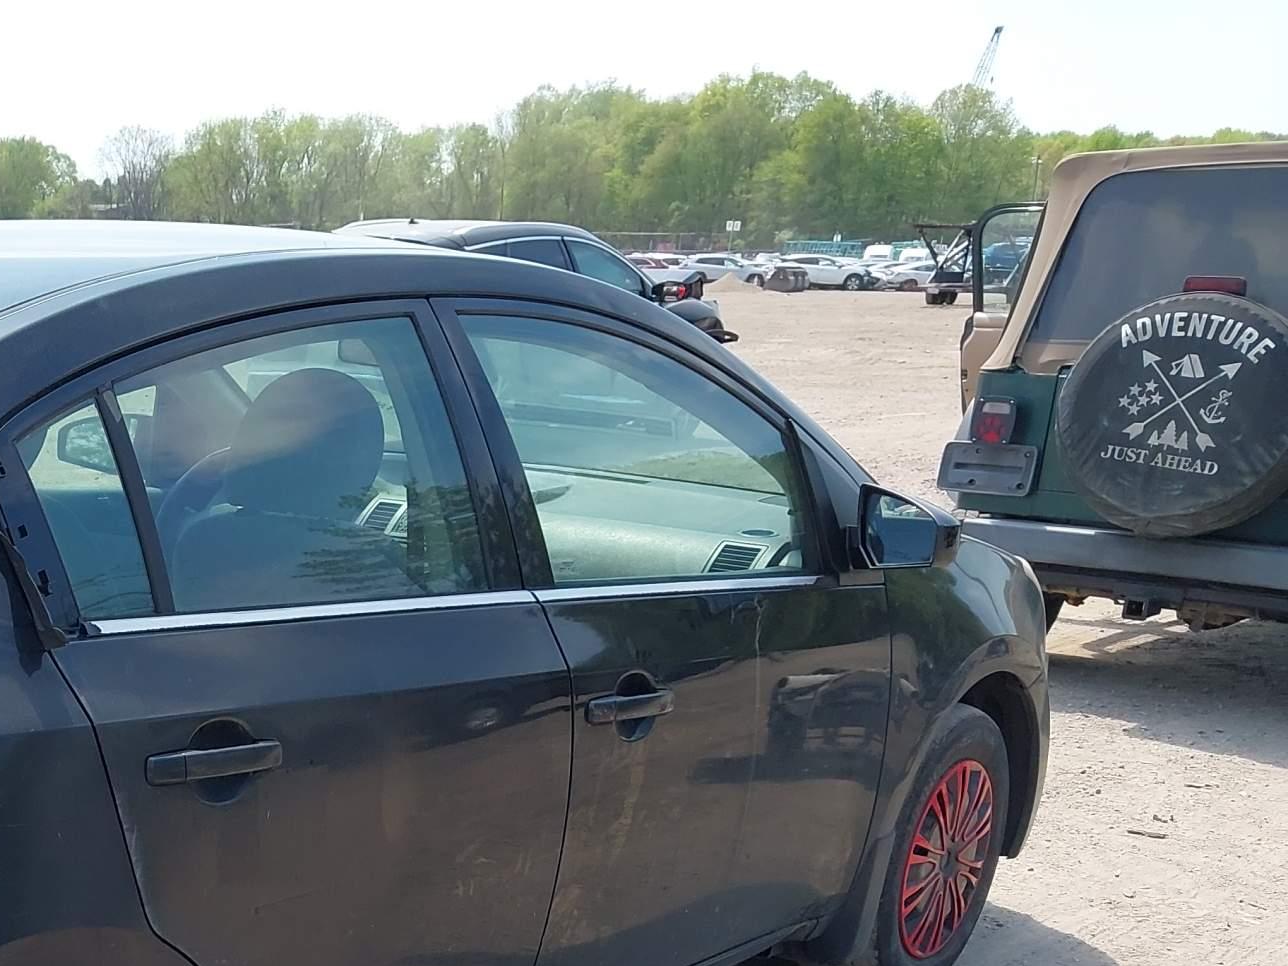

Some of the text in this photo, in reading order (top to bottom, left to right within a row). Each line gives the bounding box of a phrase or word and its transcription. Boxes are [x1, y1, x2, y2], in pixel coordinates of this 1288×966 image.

[1121, 311, 1276, 364] ADVENTURE
[1100, 444, 1219, 476] JUST AHEAD
